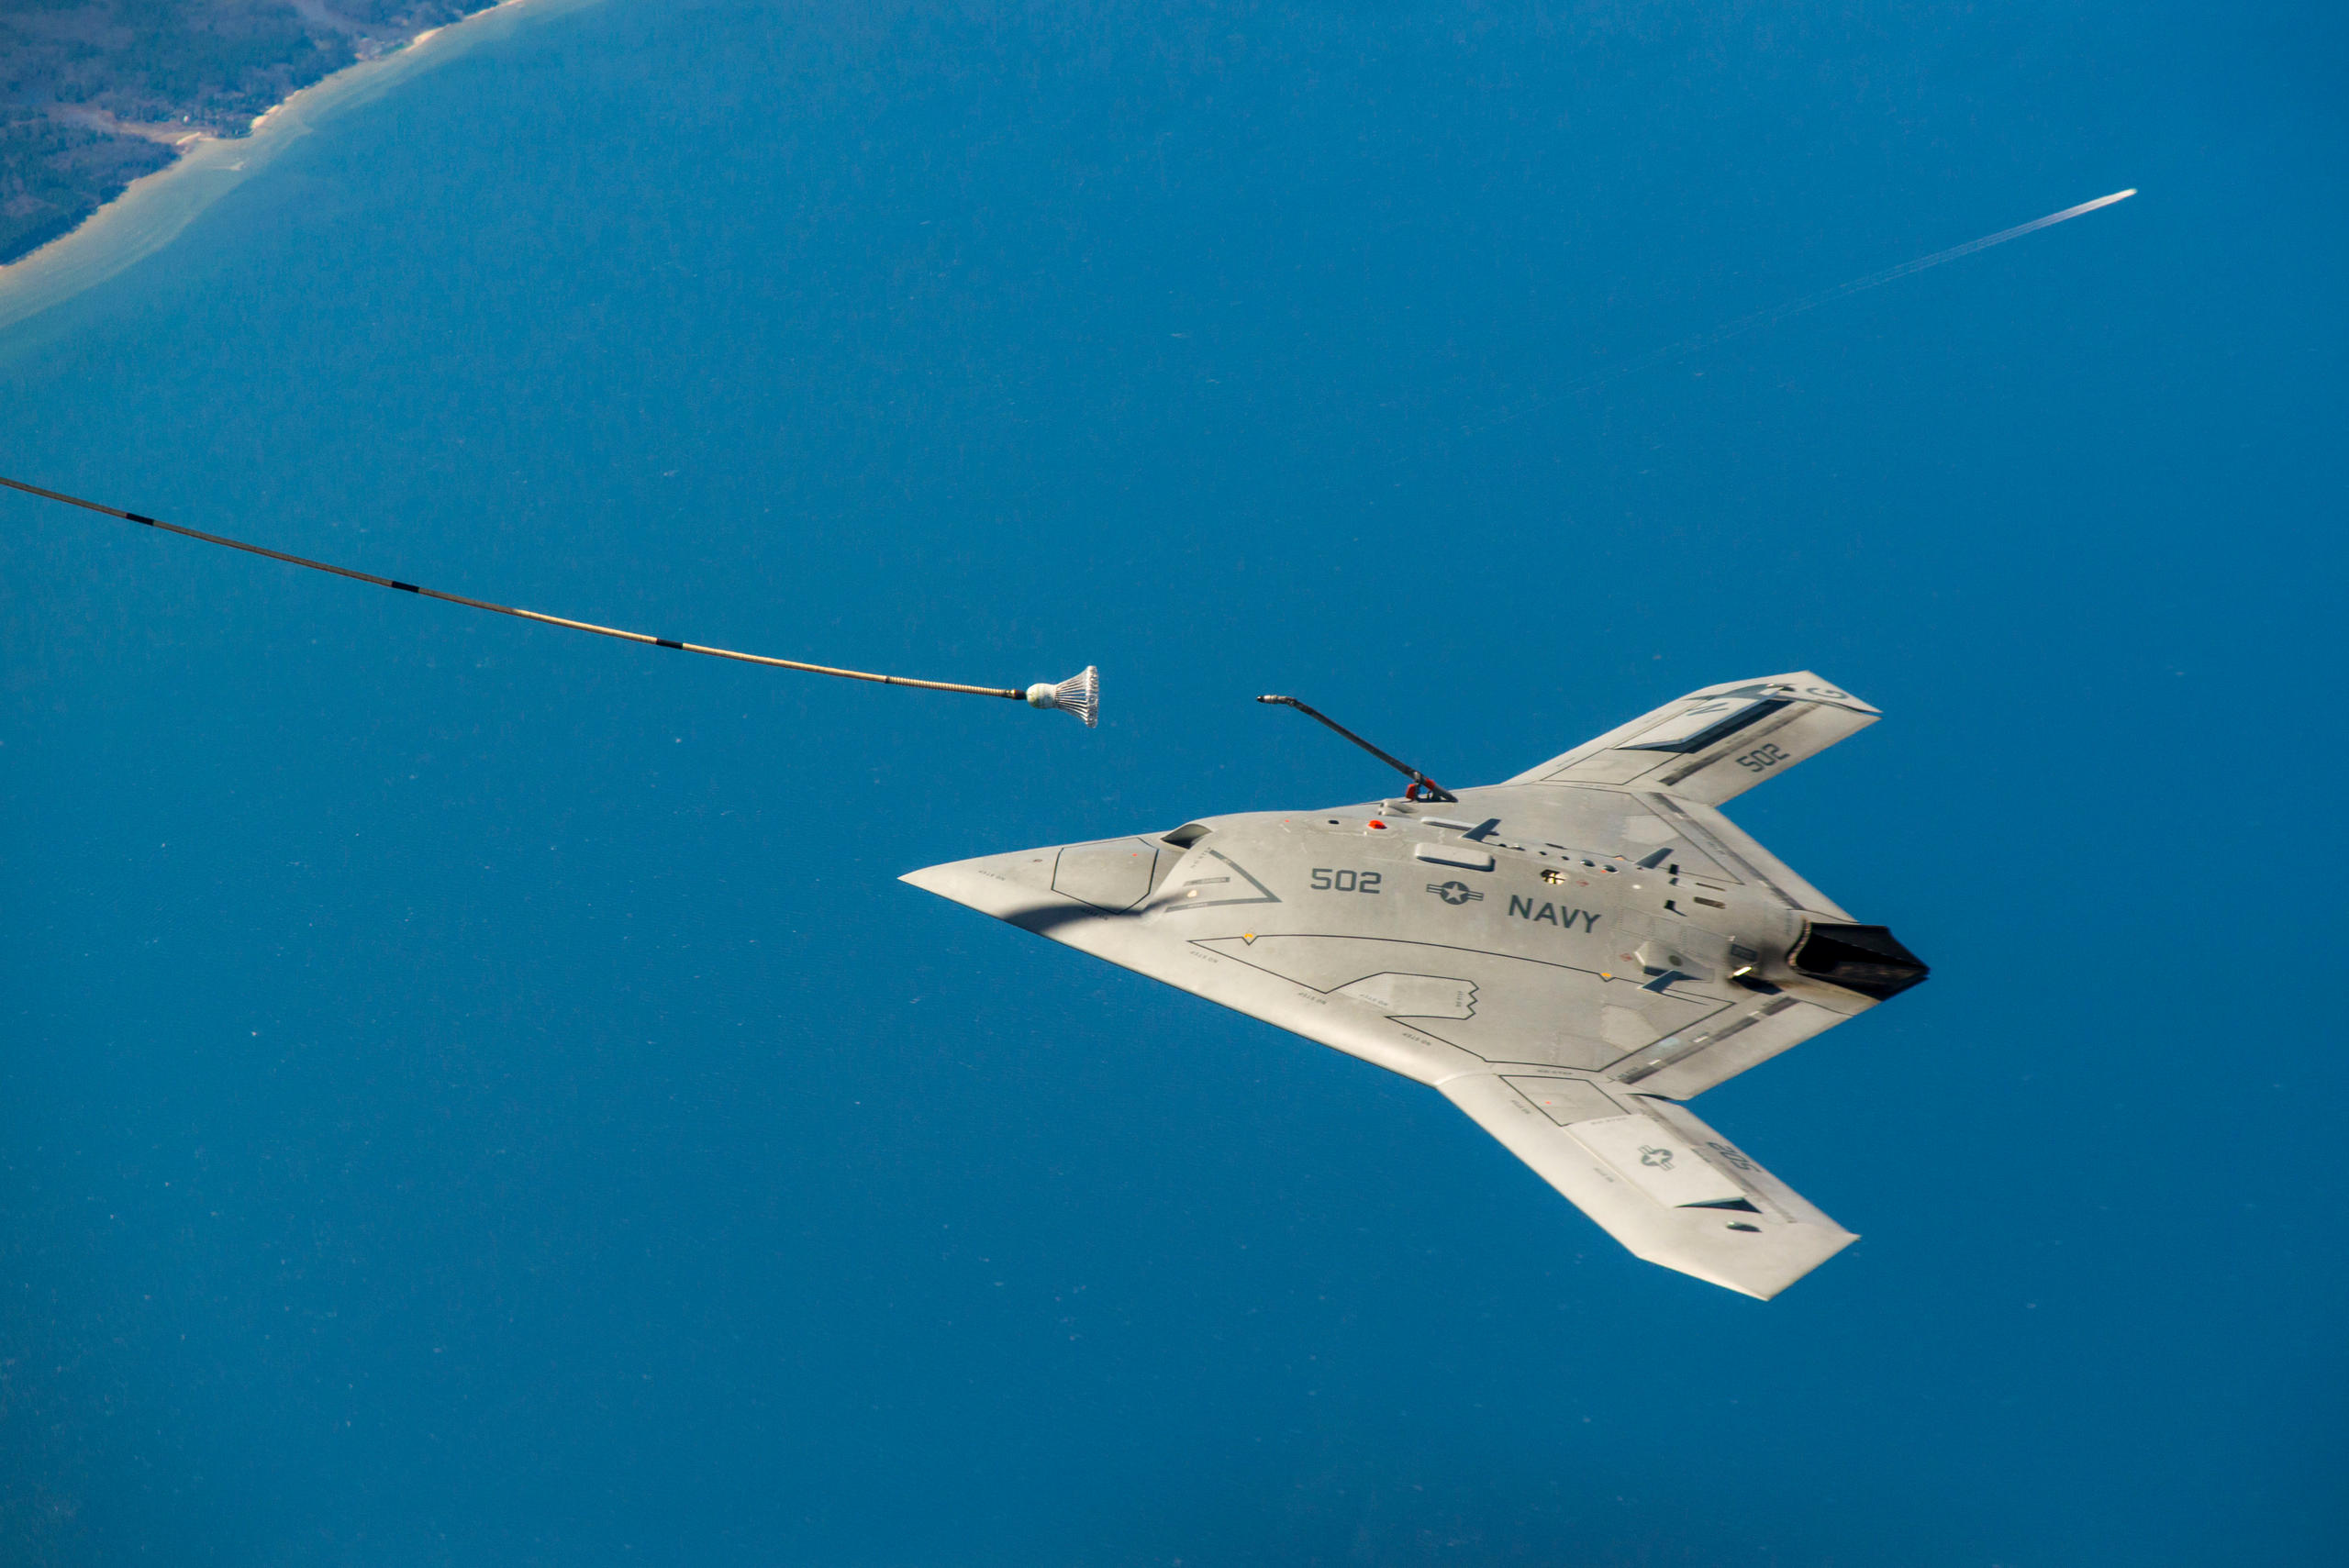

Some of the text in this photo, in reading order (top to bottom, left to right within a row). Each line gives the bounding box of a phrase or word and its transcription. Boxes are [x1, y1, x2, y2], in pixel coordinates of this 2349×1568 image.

[1736, 743, 1790, 772] 502
[1310, 868, 1382, 894] 502
[1508, 895, 1601, 933] NAVY
[1706, 1141, 1761, 1171] 502
